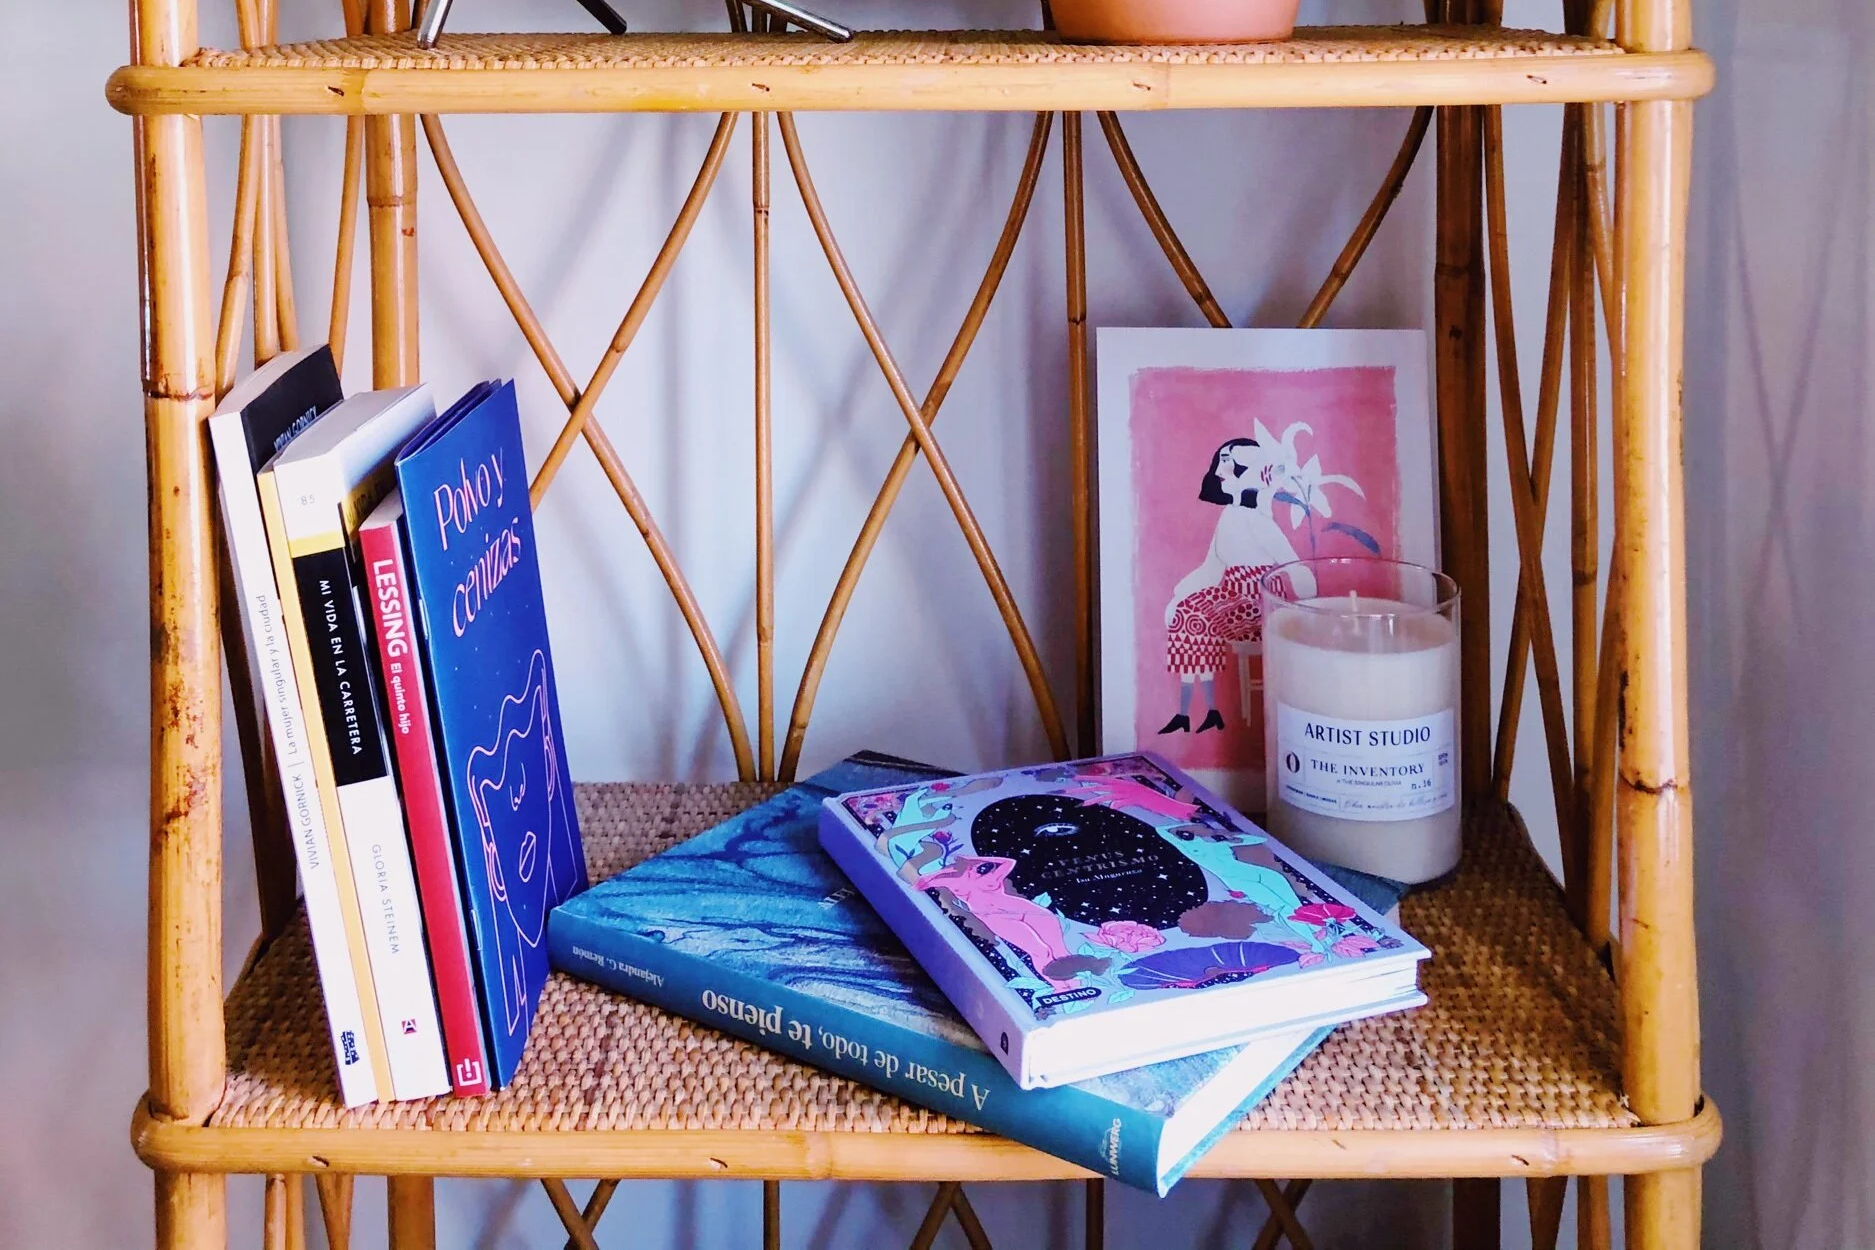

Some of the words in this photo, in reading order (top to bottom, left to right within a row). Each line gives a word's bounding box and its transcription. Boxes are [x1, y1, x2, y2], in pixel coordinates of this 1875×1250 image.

[433, 457, 491, 551] Polvo
[491, 446, 504, 508] y
[319, 579, 332, 596] MI
[452, 516, 522, 638] cenizas
[255, 595, 273, 635] ciudad
[323, 600, 339, 633] VIDA
[372, 559, 408, 658] LESSING
[330, 637, 344, 655] EN
[271, 657, 288, 705] singular
[335, 660, 347, 676] LA
[390, 663, 402, 674] El
[390, 676, 407, 712] quinto
[280, 706, 295, 739] mujer
[339, 681, 363, 755] CARRETERA
[396, 712, 413, 735] hijo
[1304, 722, 1363, 746] ARTIST
[1369, 726, 1431, 747] STUDIO
[288, 740, 299, 756] La
[1310, 759, 1338, 775] THE
[1343, 762, 1425, 777] INVENTORY
[293, 773, 313, 826] GORNICK
[303, 827, 320, 870] VIVIAN
[371, 844, 388, 893] GLORIA
[381, 898, 400, 954] STEINEM
[618, 961, 665, 989] Alejandra
[701, 988, 783, 1037] pienso
[1042, 987, 1098, 1005] DESTINO
[788, 1019, 813, 1050] te
[818, 1026, 868, 1066] todo,
[874, 1049, 899, 1079] de
[905, 1062, 966, 1099] pesar
[971, 1084, 992, 1111] A
[1109, 1117, 1122, 1176] LUNWERG
